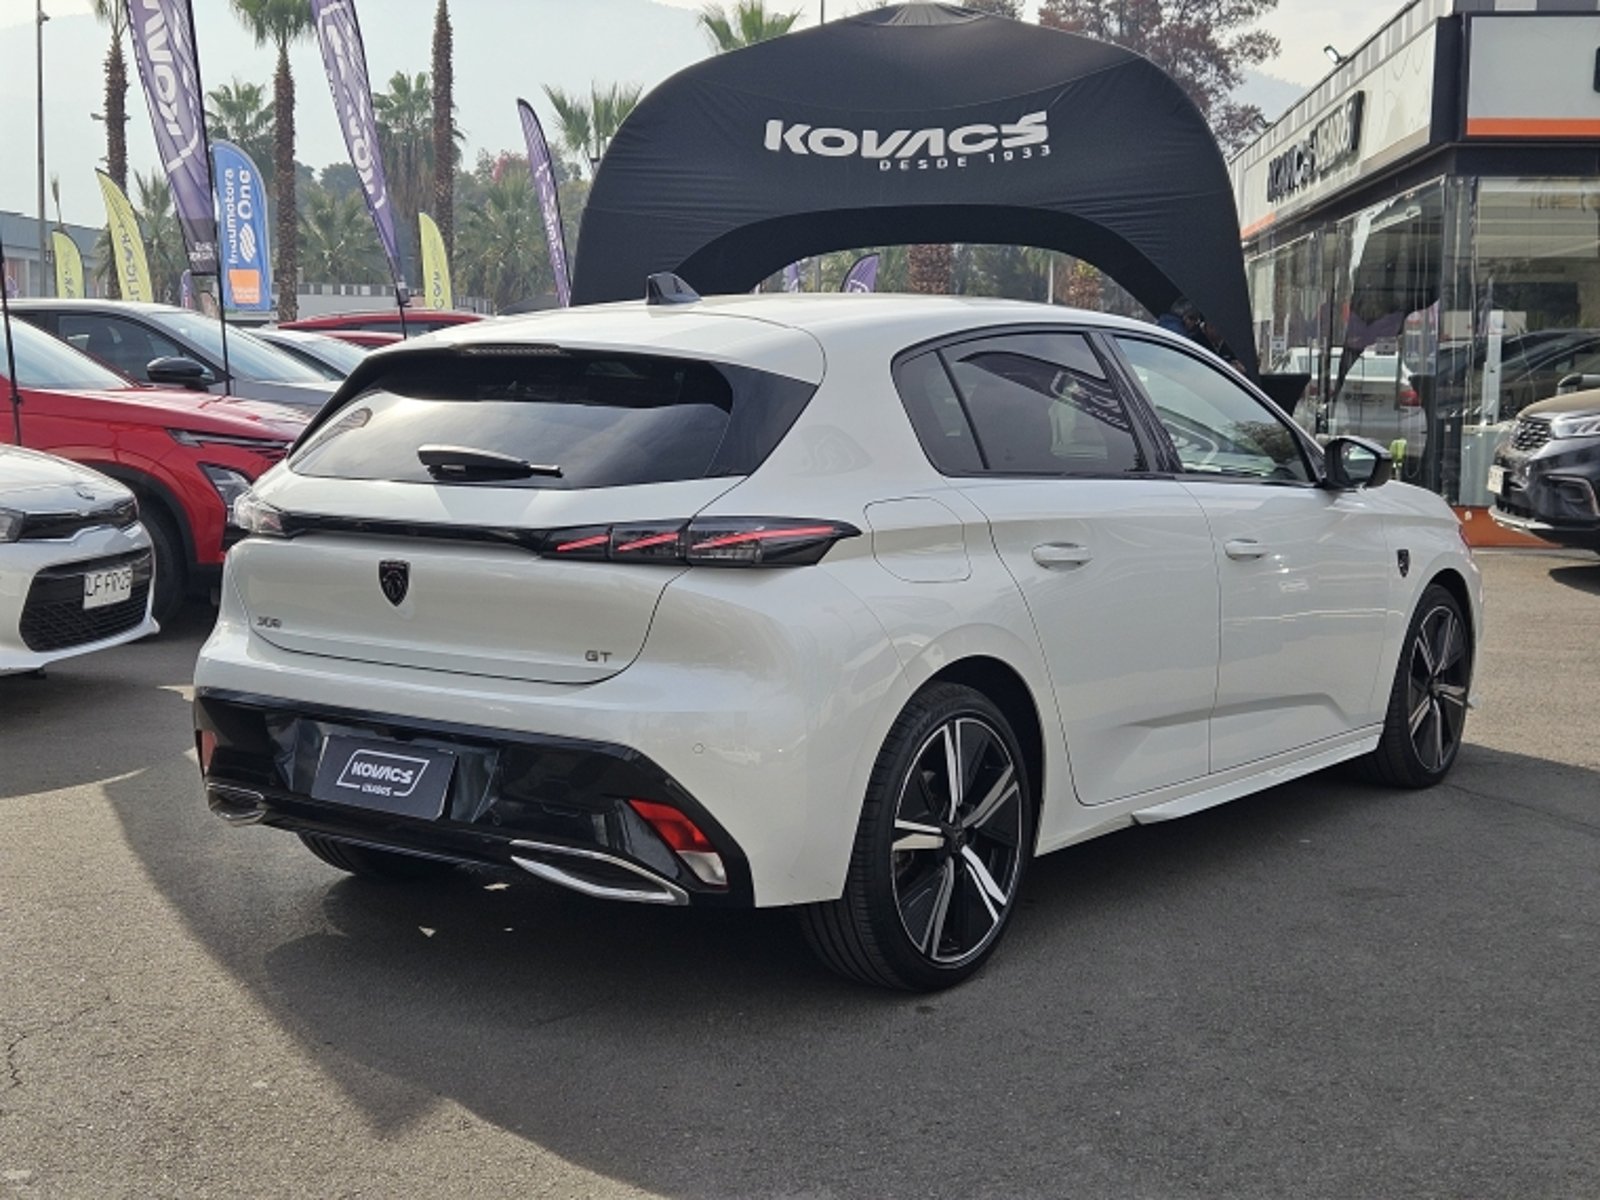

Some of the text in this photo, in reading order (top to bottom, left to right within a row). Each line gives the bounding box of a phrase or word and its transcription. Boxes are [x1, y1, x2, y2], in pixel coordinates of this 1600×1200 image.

[764, 110, 1049, 159] KOVACS
[879, 145, 1052, 171] DESDE 1933
[237, 170, 253, 220] One
[585, 650, 612, 663] GT
[351, 761, 413, 784] KOVACS
